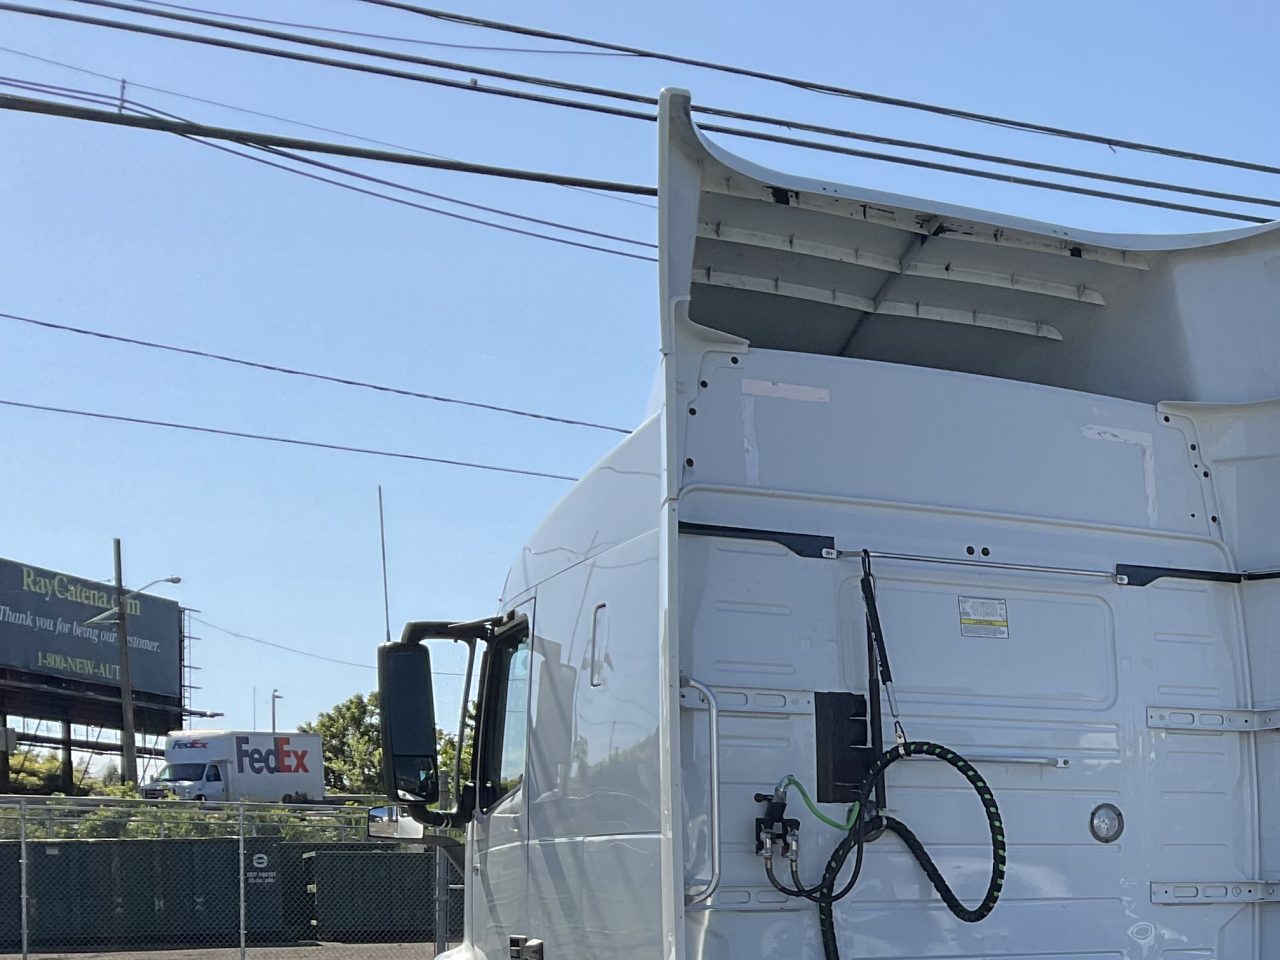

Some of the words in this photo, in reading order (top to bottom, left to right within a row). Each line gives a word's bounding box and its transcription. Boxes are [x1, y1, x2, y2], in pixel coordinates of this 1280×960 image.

[23, 567, 140, 615] RayCatena.cm
[0, 605, 33, 627] Thank
[34, 614, 54, 632] you
[55, 617, 70, 634] for
[73, 622, 99, 643] being
[38, 651, 122, 680] 1-800-NEW-AUT
[172, 739, 208, 750] FedEx
[235, 736, 309, 775] FedEx
